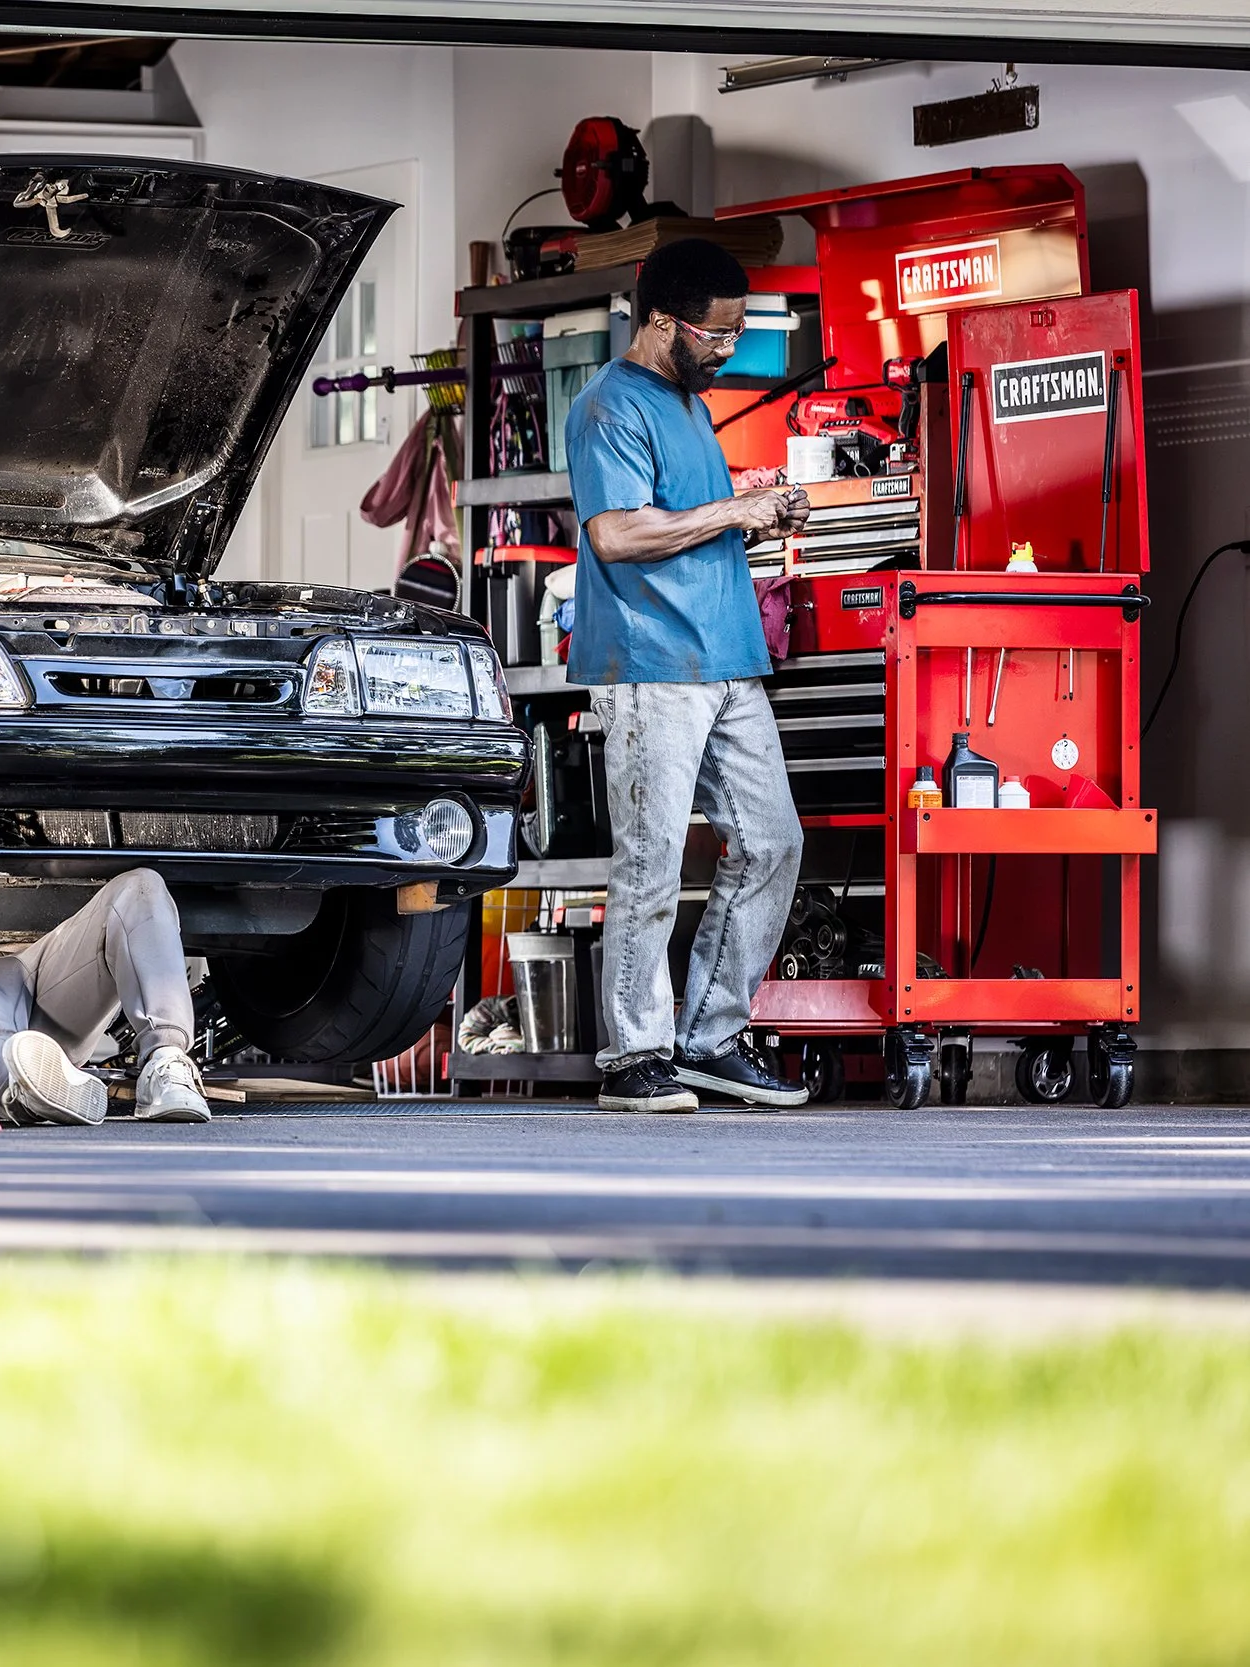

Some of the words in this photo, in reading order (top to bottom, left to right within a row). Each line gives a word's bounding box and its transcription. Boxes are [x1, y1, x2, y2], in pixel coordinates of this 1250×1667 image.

[903, 254, 994, 295] CRAFTSMAN
[874, 480, 907, 497] CRAFTSMAN
[844, 592, 879, 605] CRAFTSMAN
